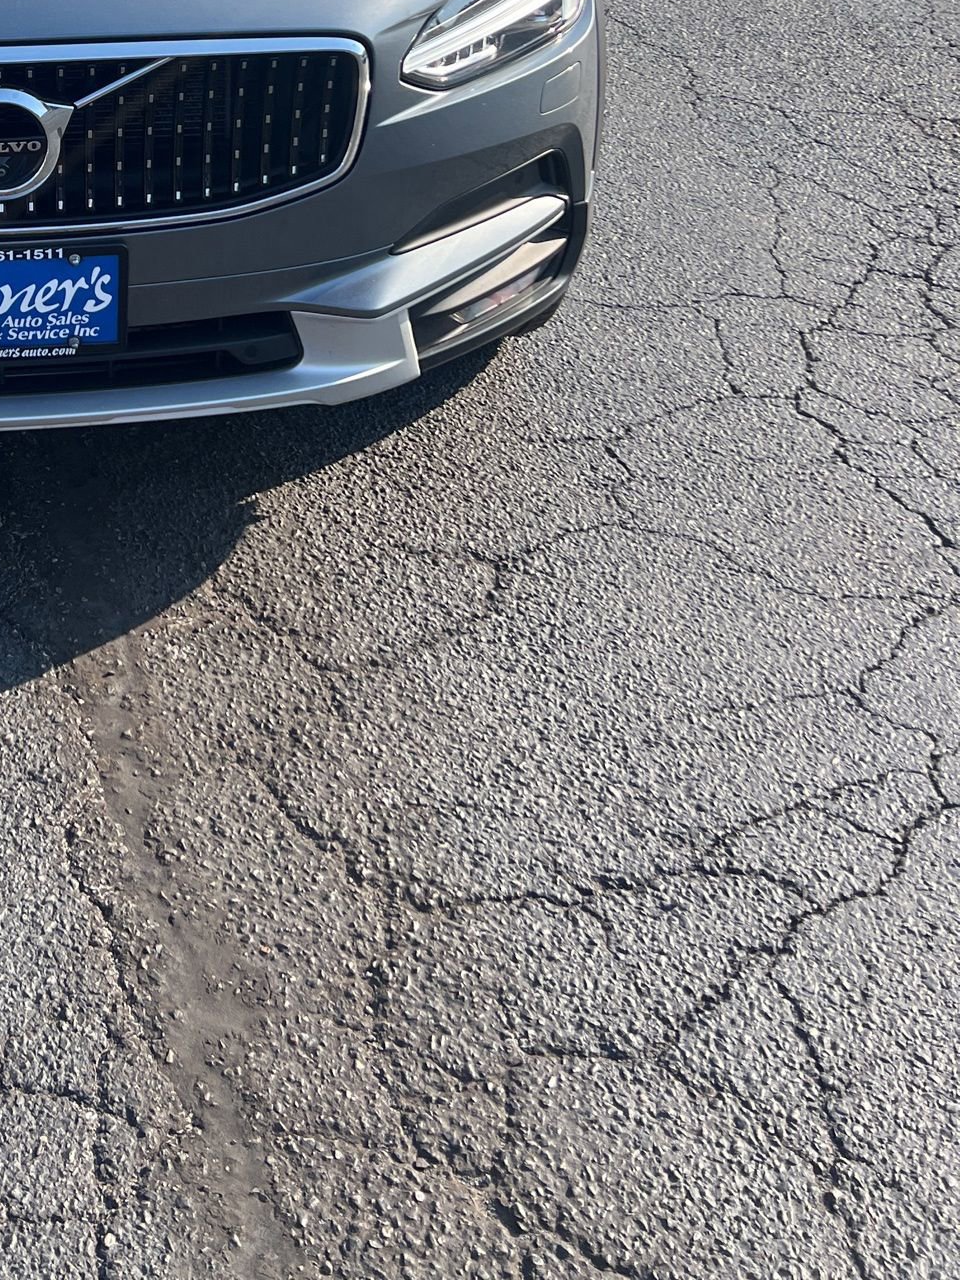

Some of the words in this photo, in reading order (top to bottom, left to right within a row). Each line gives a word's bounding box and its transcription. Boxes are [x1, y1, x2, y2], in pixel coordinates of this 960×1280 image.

[1, 315, 42, 328] Auto
[47, 311, 90, 327] Sales
[7, 326, 70, 340] Service
[74, 324, 100, 337] Inc
